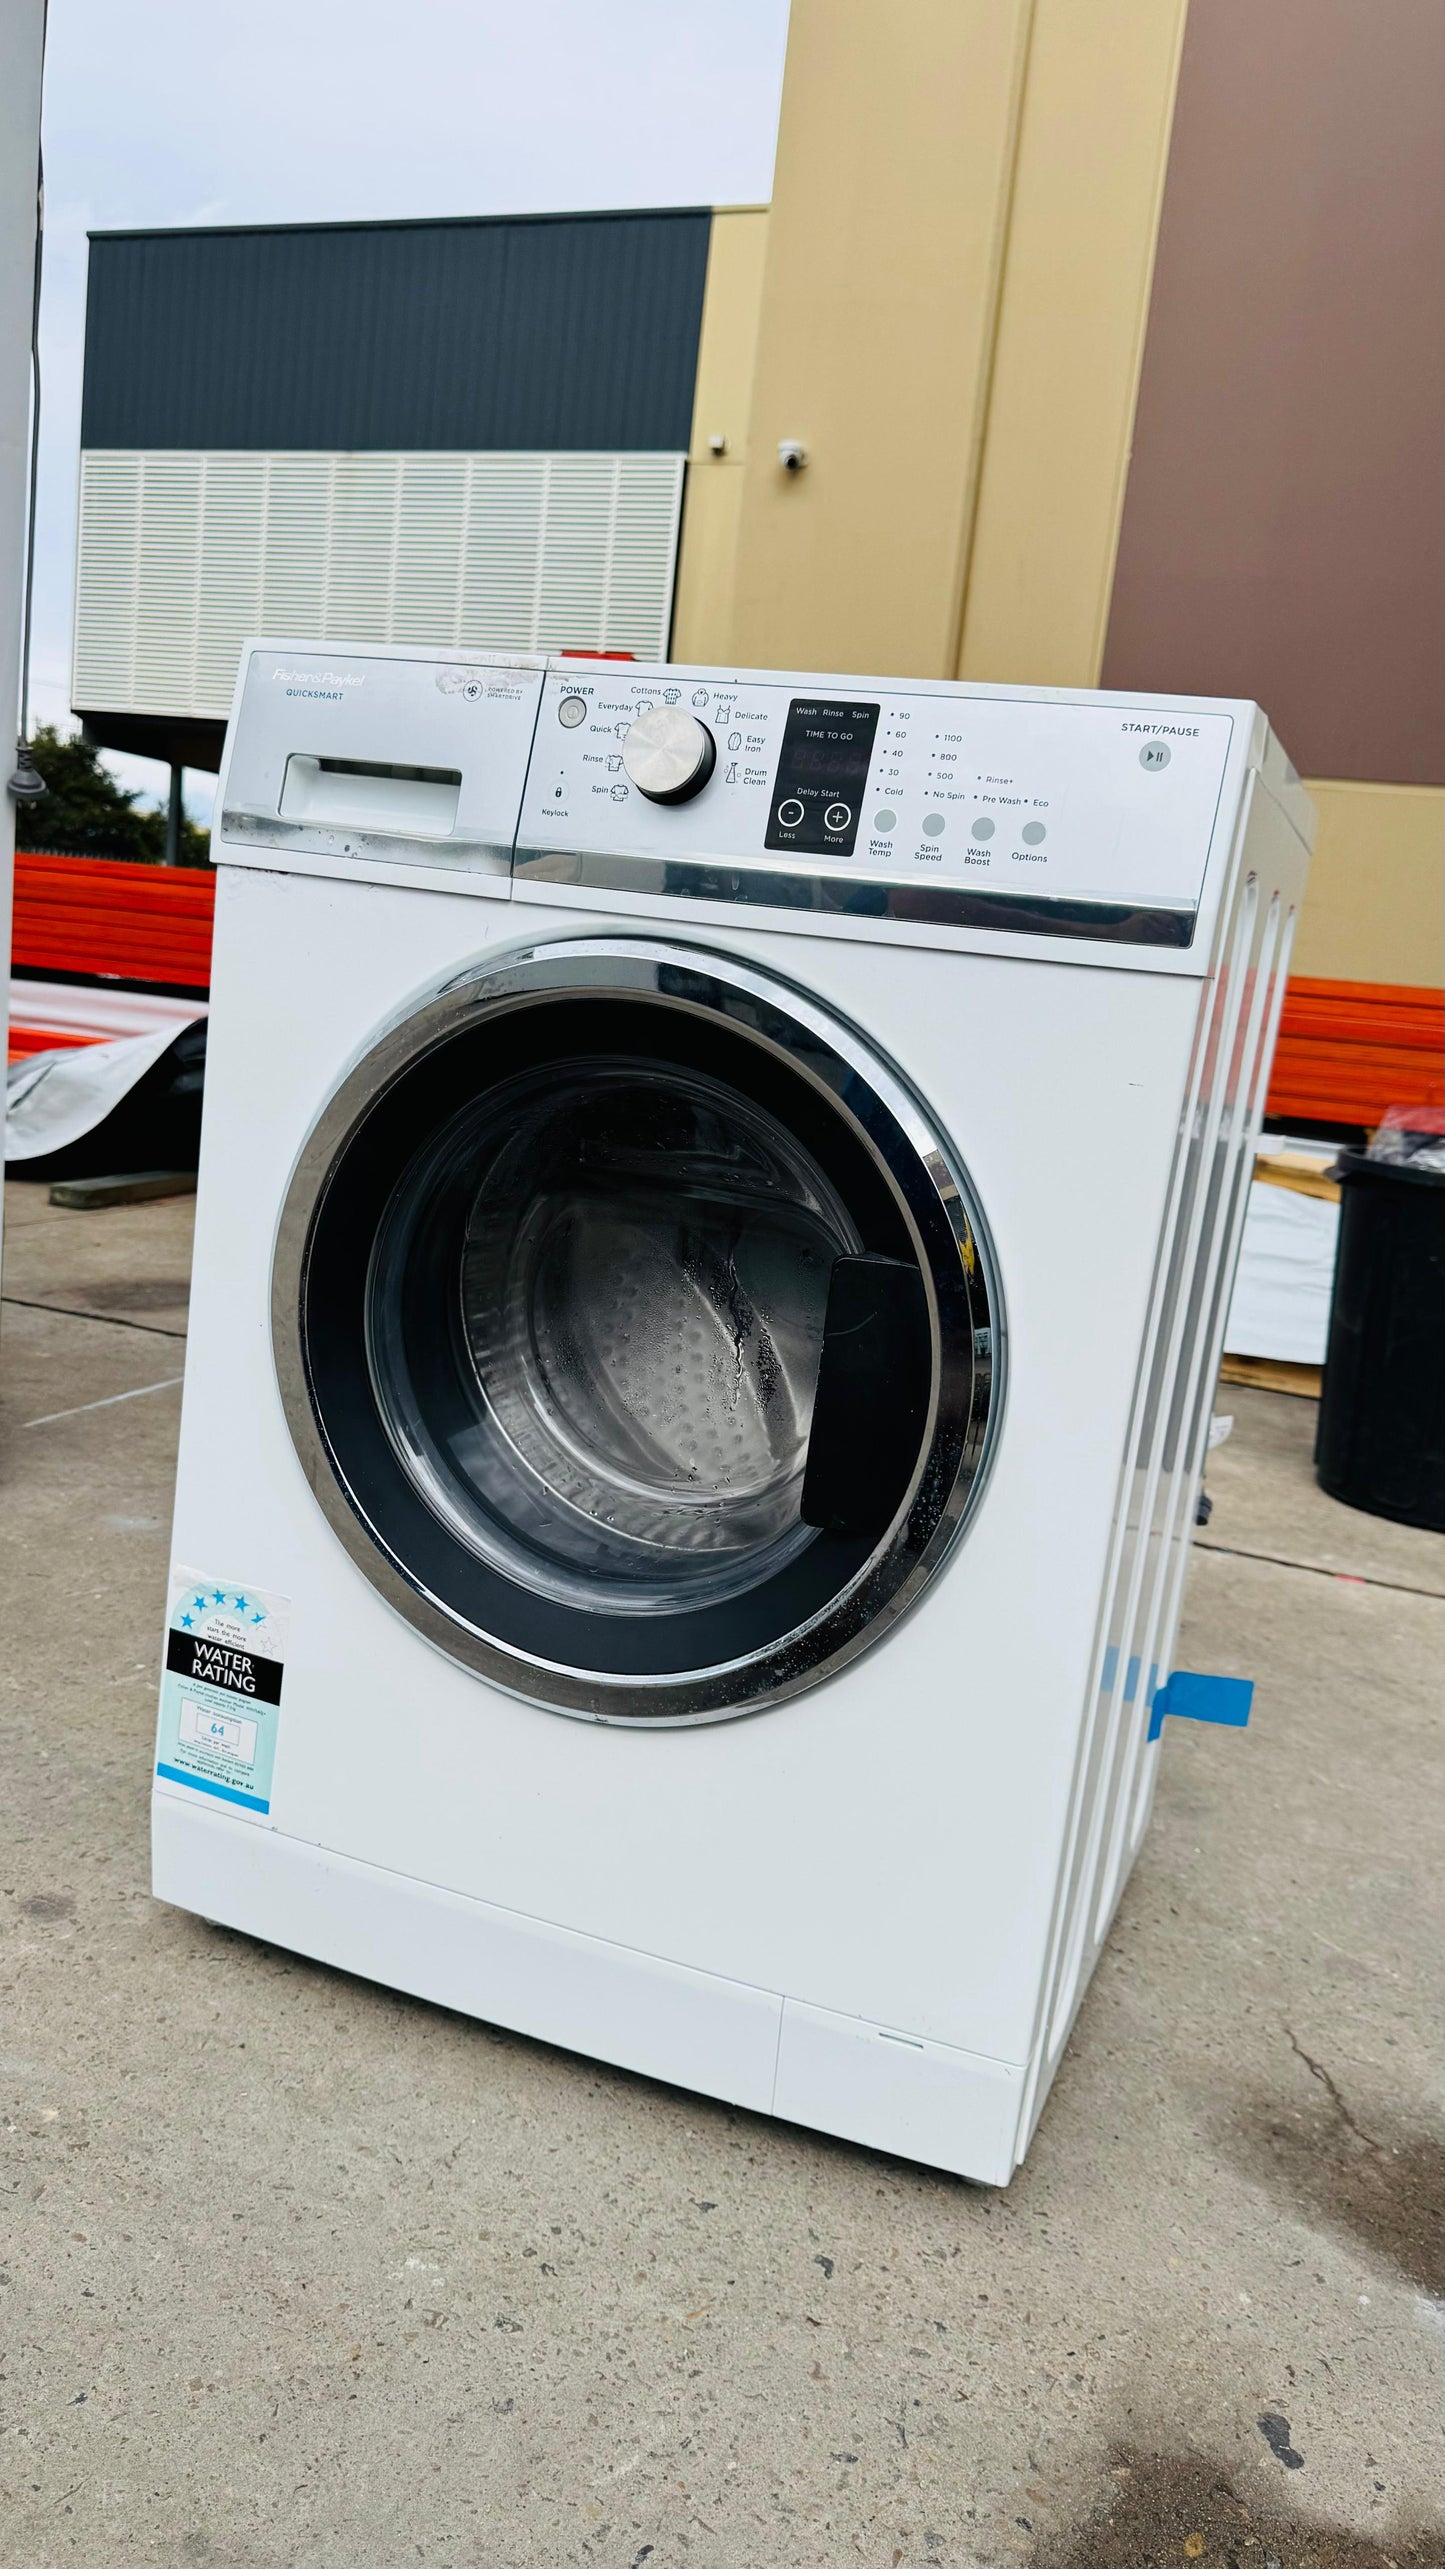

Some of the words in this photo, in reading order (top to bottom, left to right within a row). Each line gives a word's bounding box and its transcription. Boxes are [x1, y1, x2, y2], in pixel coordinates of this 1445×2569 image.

[286, 688, 344, 700] QUICKSMART
[560, 686, 594, 695] POWER
[631, 686, 661, 695] Cottons
[713, 692, 738, 702] Heavy
[598, 702, 633, 712] Everyday
[735, 711, 768, 721] Delicate
[796, 707, 817, 716] Wash
[822, 709, 844, 717] Rinse
[852, 711, 870, 719] Spin
[899, 712, 910, 720] 90
[590, 725, 612, 733] Quick
[1121, 723, 1200, 737] START/PAUSE
[805, 730, 824, 739] TIME
[827, 732, 838, 740] TO
[840, 733, 854, 741] GO
[895, 730, 907, 739] 60
[943, 734, 962, 742] 1100
[746, 735, 766, 745] Easy
[745, 745, 761, 753] Iron
[892, 750, 903, 758] 40
[940, 753, 957, 761] 800
[582, 755, 603, 763] Rinse
[745, 768, 767, 776] Drum
[888, 768, 899, 776] 30
[936, 772, 953, 780] 500
[743, 777, 766, 786] Clean
[985, 776, 1013, 785] Rinse+
[592, 785, 608, 794] Spin
[797, 787, 819, 797] Delay
[820, 789, 840, 798] Start
[884, 787, 904, 796] Cold
[932, 791, 945, 799] No
[947, 792, 965, 800] Spin
[982, 795, 996, 803] Pre
[999, 797, 1021, 806] Wash
[1033, 799, 1049, 807] Eco
[541, 808, 568, 817] Keylock
[778, 831, 796, 839] Less
[824, 835, 844, 844] More
[869, 839, 893, 849] Wash
[920, 843, 939, 853] Spin
[868, 847, 891, 857] Temp
[967, 848, 991, 857] Wash
[914, 852, 942, 862] Speed
[964, 856, 990, 866] Boost
[1011, 852, 1048, 863] Options
[194, 1641, 252, 1674] WATER
[191, 1658, 256, 1692] RATING
[211, 1723, 225, 1736] 64
